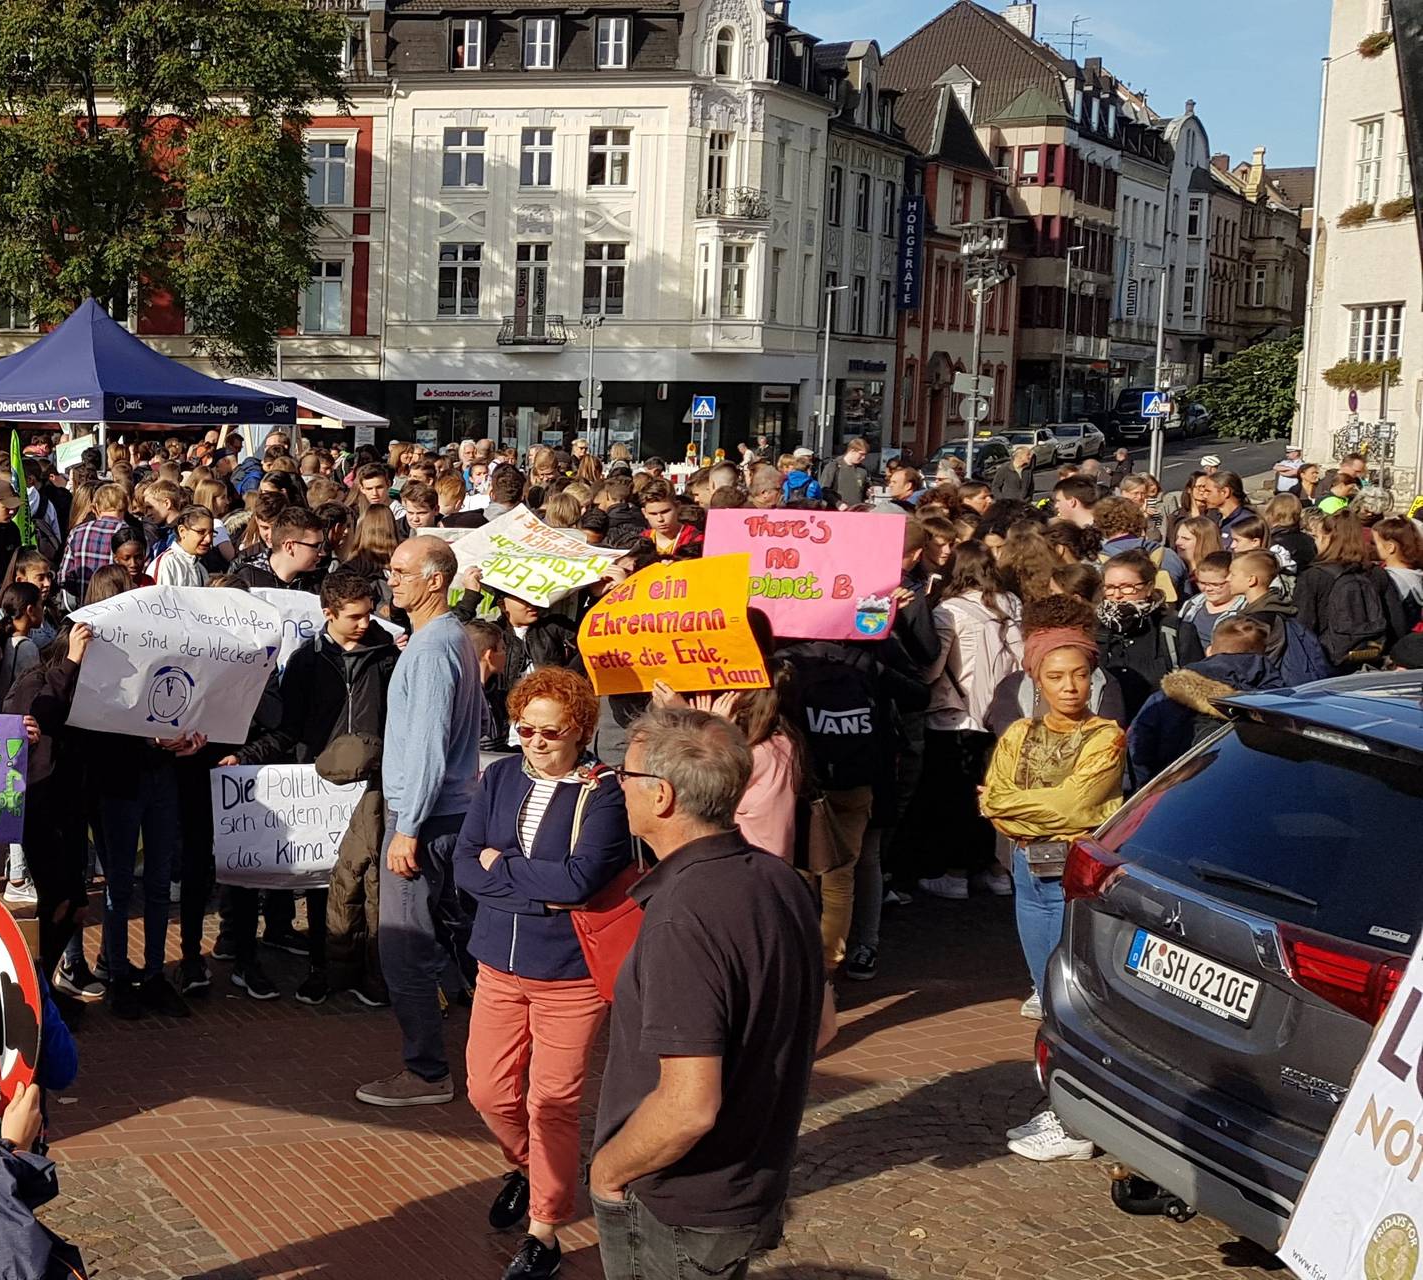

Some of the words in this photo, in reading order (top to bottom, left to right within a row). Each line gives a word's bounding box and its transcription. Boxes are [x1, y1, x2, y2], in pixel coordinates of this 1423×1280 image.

[71, 399, 90, 409] adfc
[433, 390, 471, 398] Santander
[472, 390, 494, 398] Select
[172, 403, 239, 416] www.adfc-berg.de
[649, 576, 688, 600] ein
[831, 574, 856, 600] B
[131, 595, 187, 620] habt
[588, 608, 726, 638] Ehrenmann
[139, 631, 169, 650] sind
[180, 637, 204, 657] der
[639, 648, 668, 667] die
[806, 706, 873, 735] VANS
[221, 774, 256, 810] Die
[220, 813, 256, 835] sich
[227, 845, 262, 871] das
[1141, 939, 1158, 971] K
[1163, 950, 1190, 986] SH
[1189, 962, 1254, 1014] 6210E
[1373, 1215, 1407, 1244] FRIDAYS
